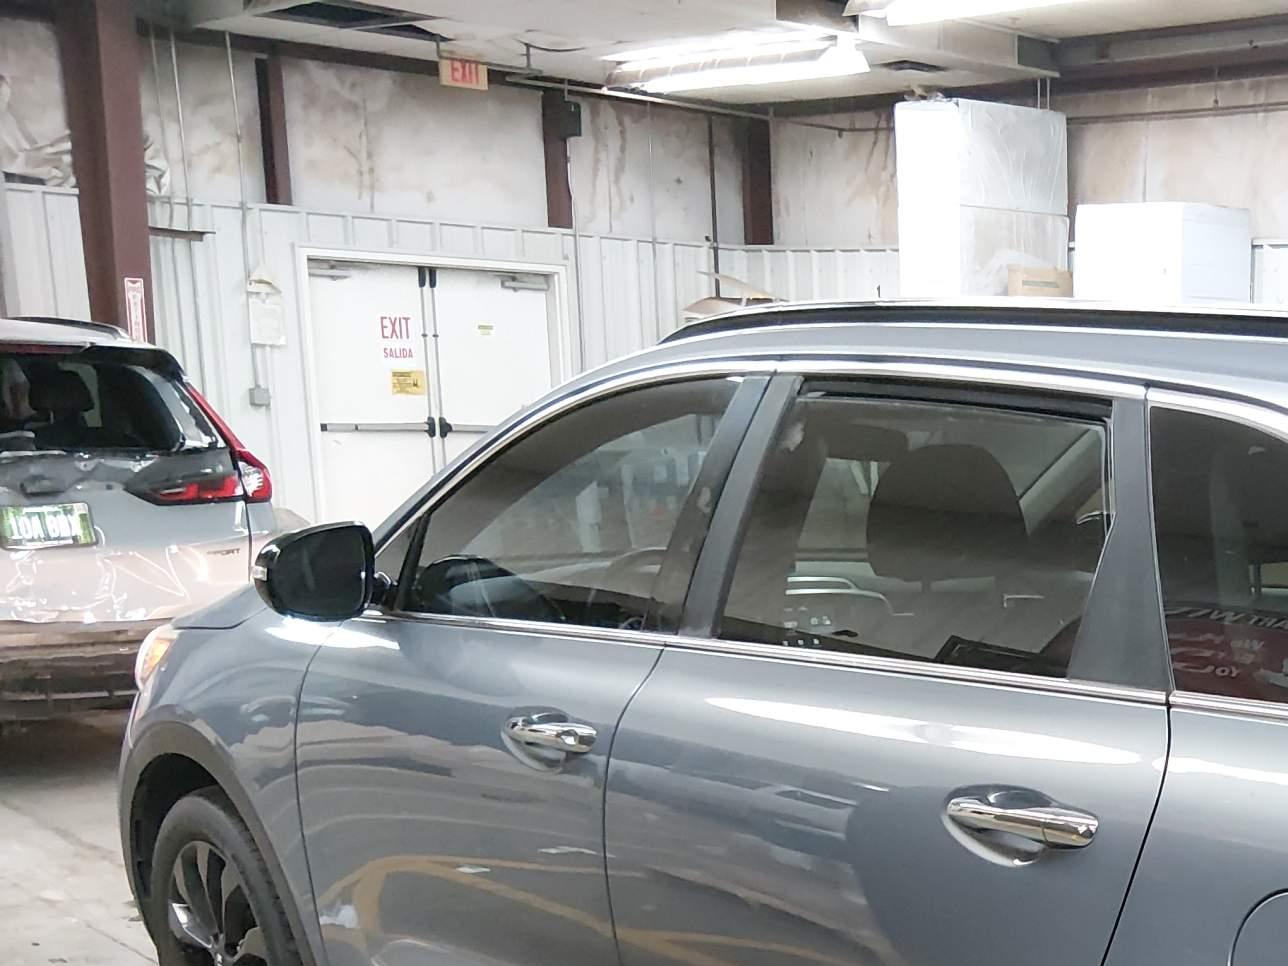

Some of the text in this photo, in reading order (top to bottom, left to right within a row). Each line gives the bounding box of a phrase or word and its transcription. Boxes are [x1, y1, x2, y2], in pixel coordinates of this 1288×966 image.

[450, 59, 480, 84] EXIT
[380, 316, 411, 340] EXIT
[383, 347, 414, 359] SALIDA
